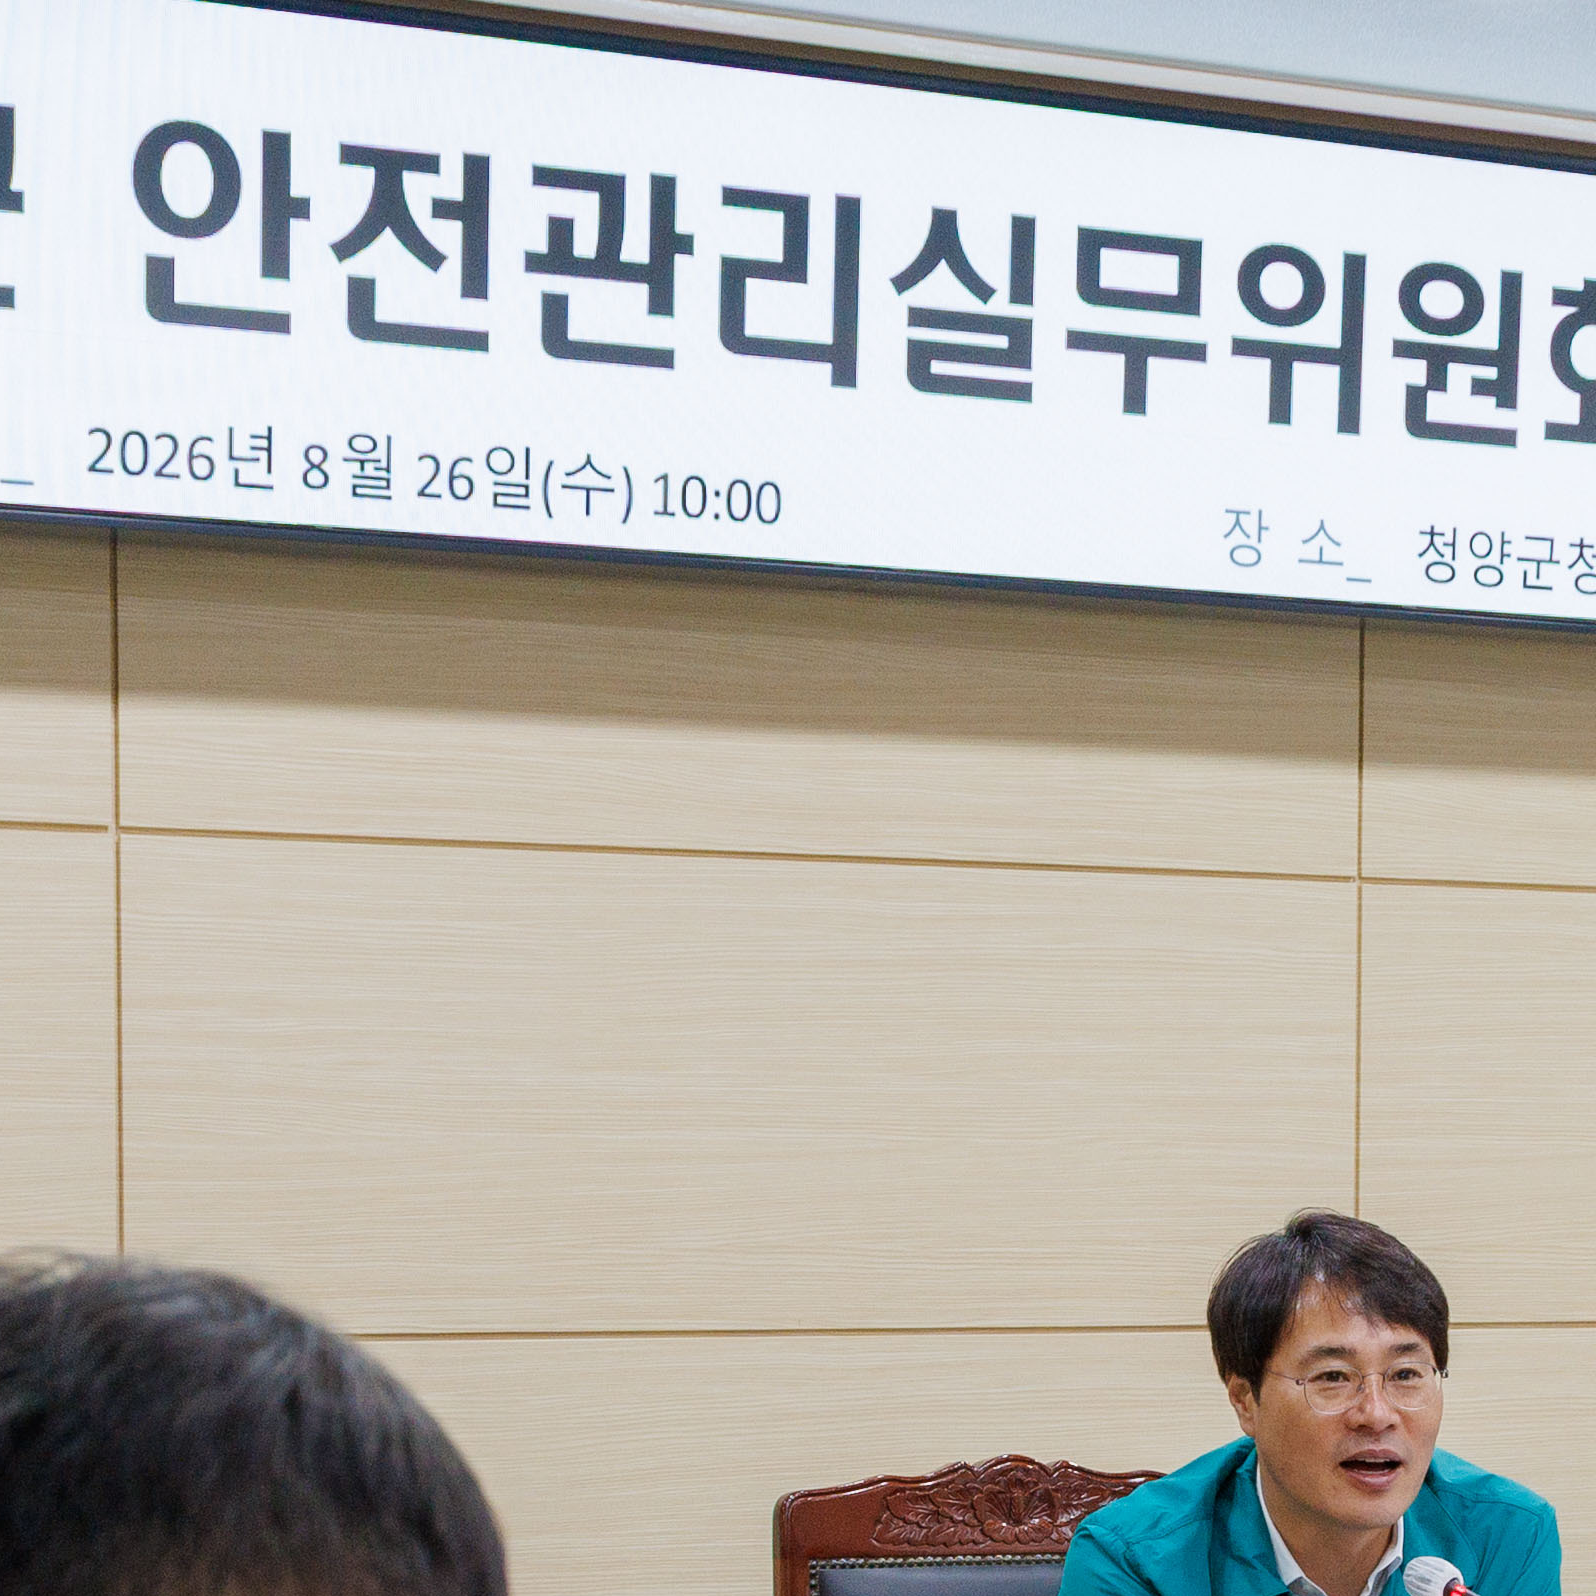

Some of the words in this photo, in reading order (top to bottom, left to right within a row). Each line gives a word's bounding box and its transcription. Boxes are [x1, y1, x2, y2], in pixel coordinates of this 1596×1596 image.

[86, 424, 275, 492] 2026년
[301, 433, 394, 502] 8월
[416, 445, 634, 526] 26일(수)
[653, 471, 783, 526] 10:00
